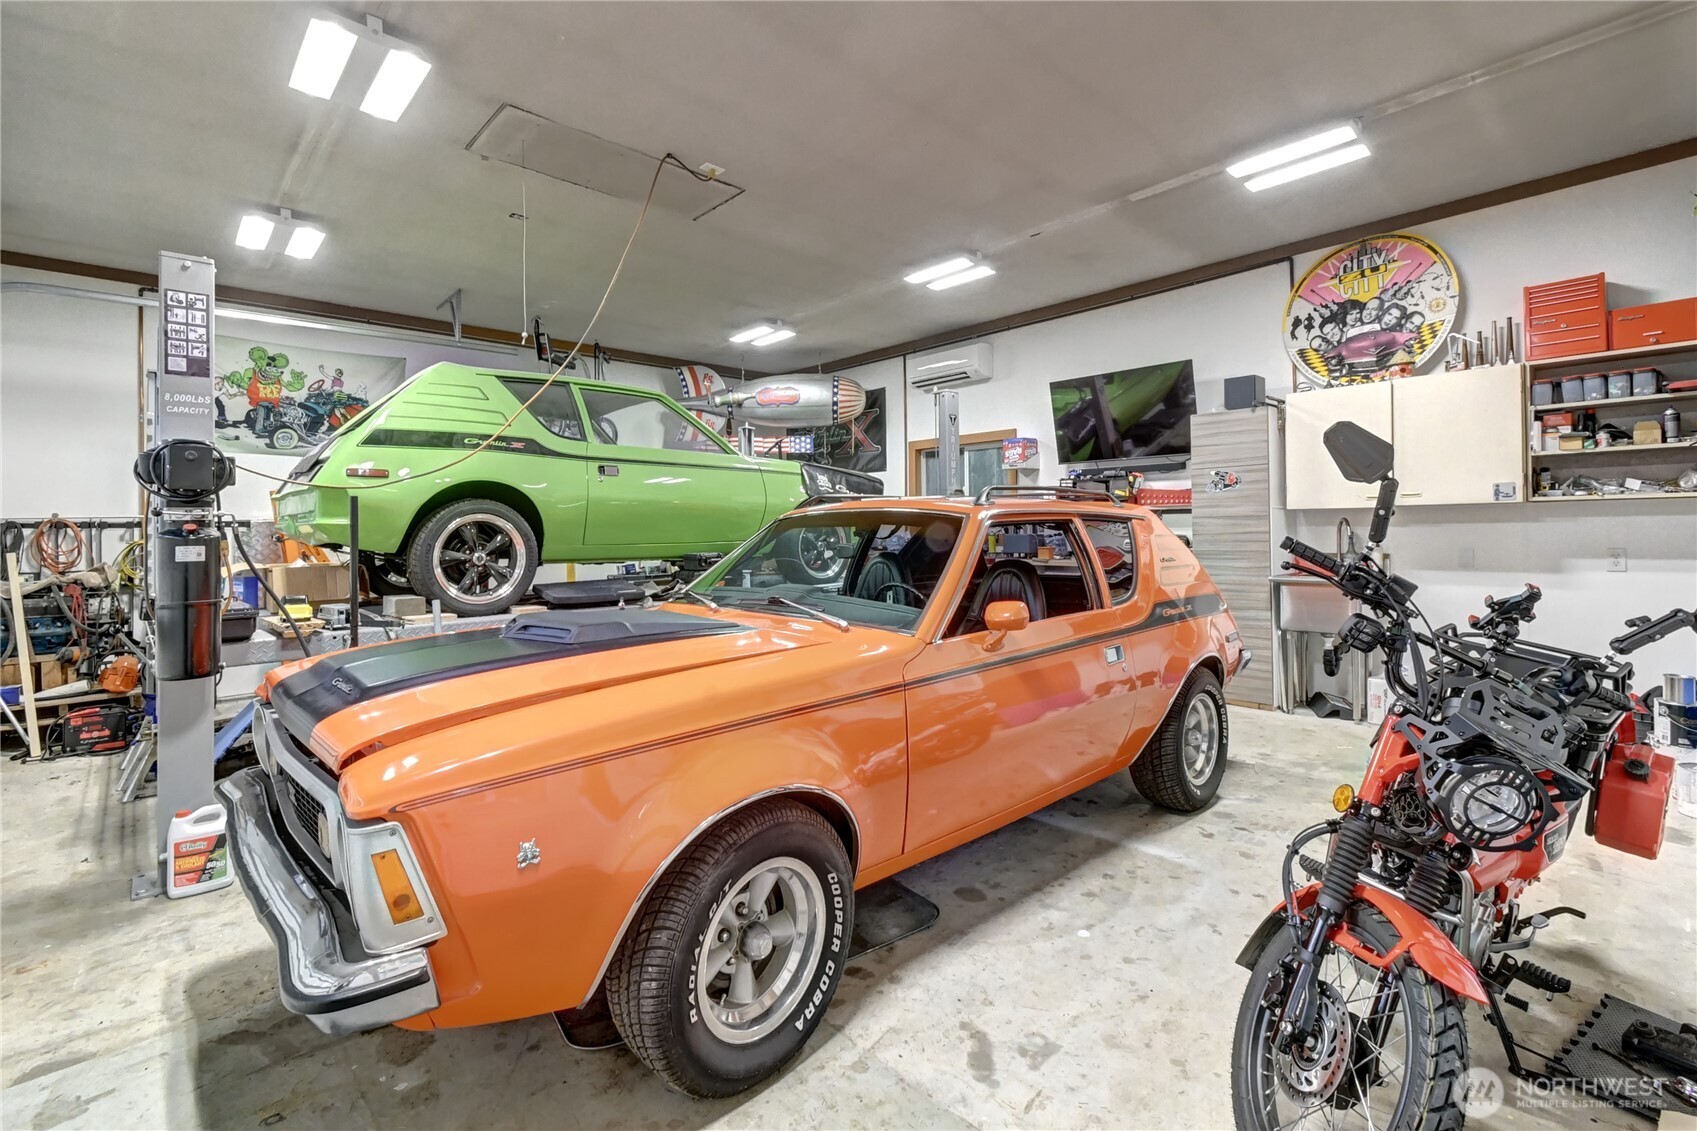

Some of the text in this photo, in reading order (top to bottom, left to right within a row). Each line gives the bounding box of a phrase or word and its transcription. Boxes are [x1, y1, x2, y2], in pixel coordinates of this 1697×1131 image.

[1339, 250, 1387, 276] CITY
[164, 392, 211, 404] 8,000LbS
[166, 405, 210, 415] CAPACITY
[464, 437, 509, 447] Grmlin
[1204, 684, 1228, 744] COOPER COBRA
[794, 872, 844, 1032] COOPER COBRA
[688, 927, 709, 1024] RADIAL
